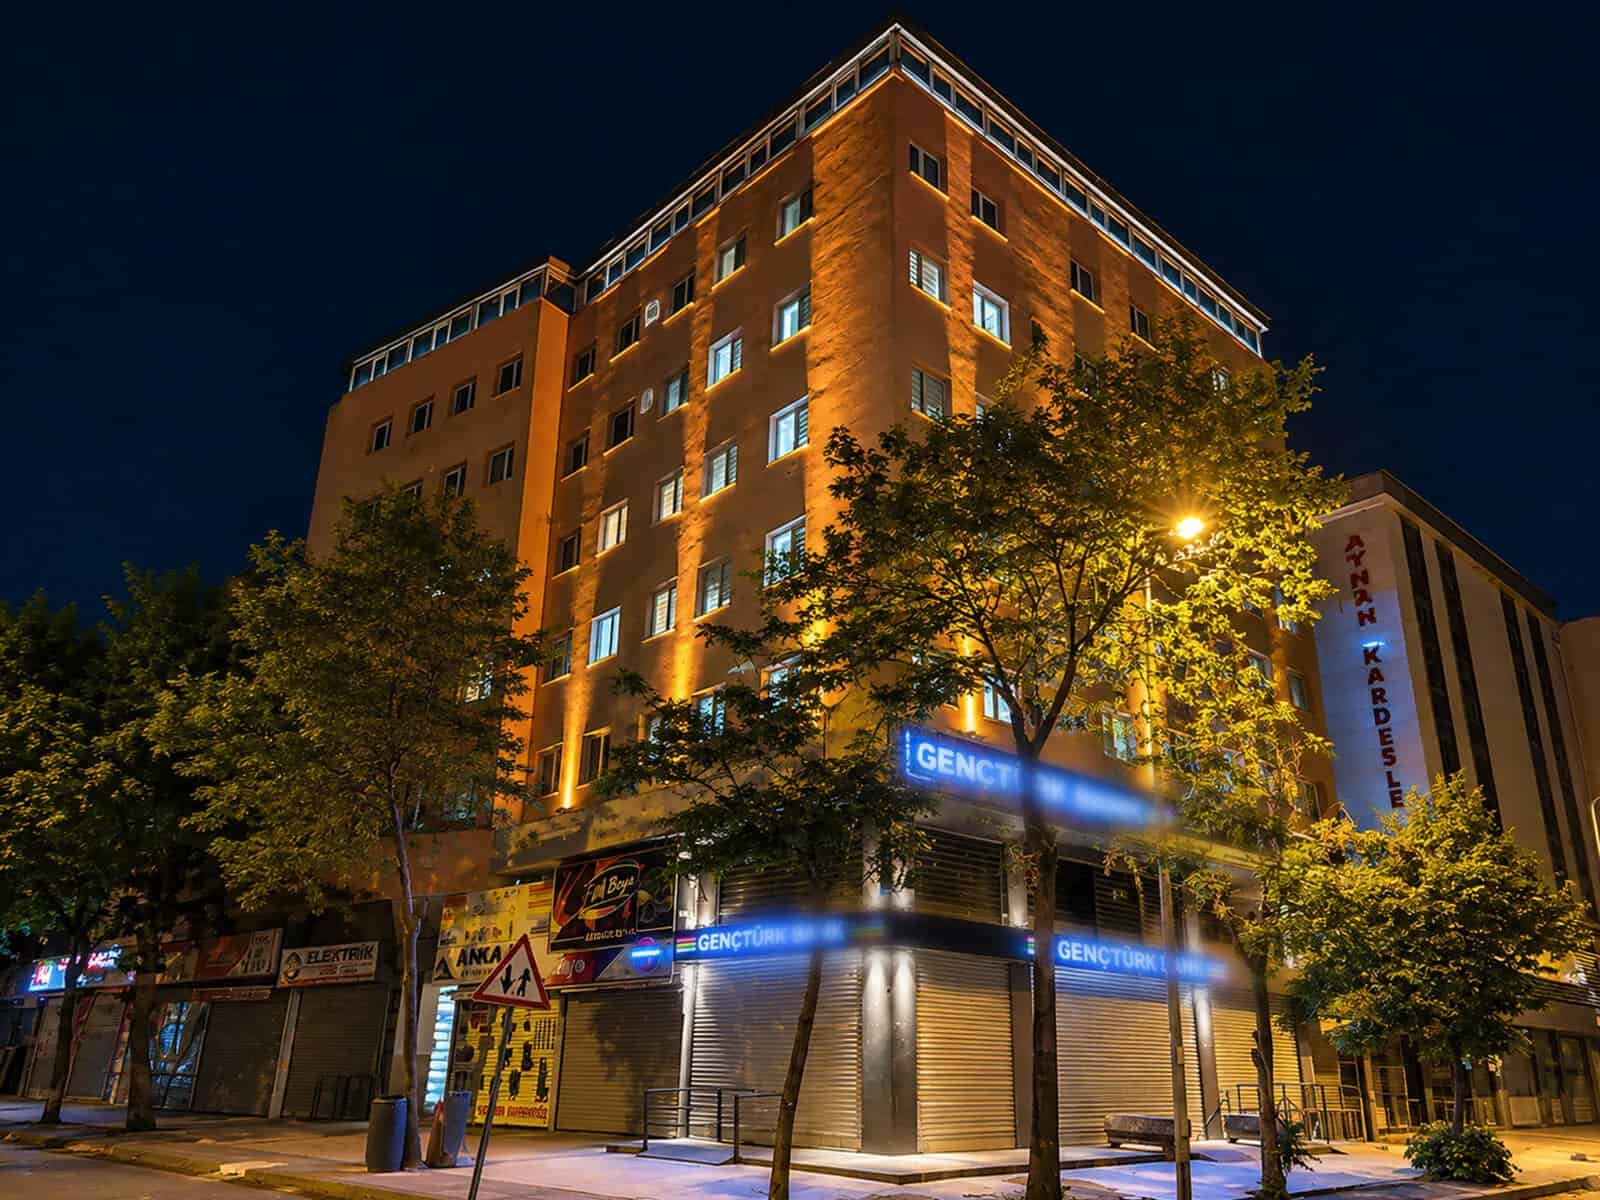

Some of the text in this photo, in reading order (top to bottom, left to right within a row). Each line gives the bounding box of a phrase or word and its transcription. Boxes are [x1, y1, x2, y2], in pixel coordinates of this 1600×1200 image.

[1344, 534, 1377, 626] AYNAN
[697, 924, 787, 952] GENÇTÜRK
[456, 945, 502, 967] ANKA
[1057, 940, 1157, 972] GENÇTÜRK
